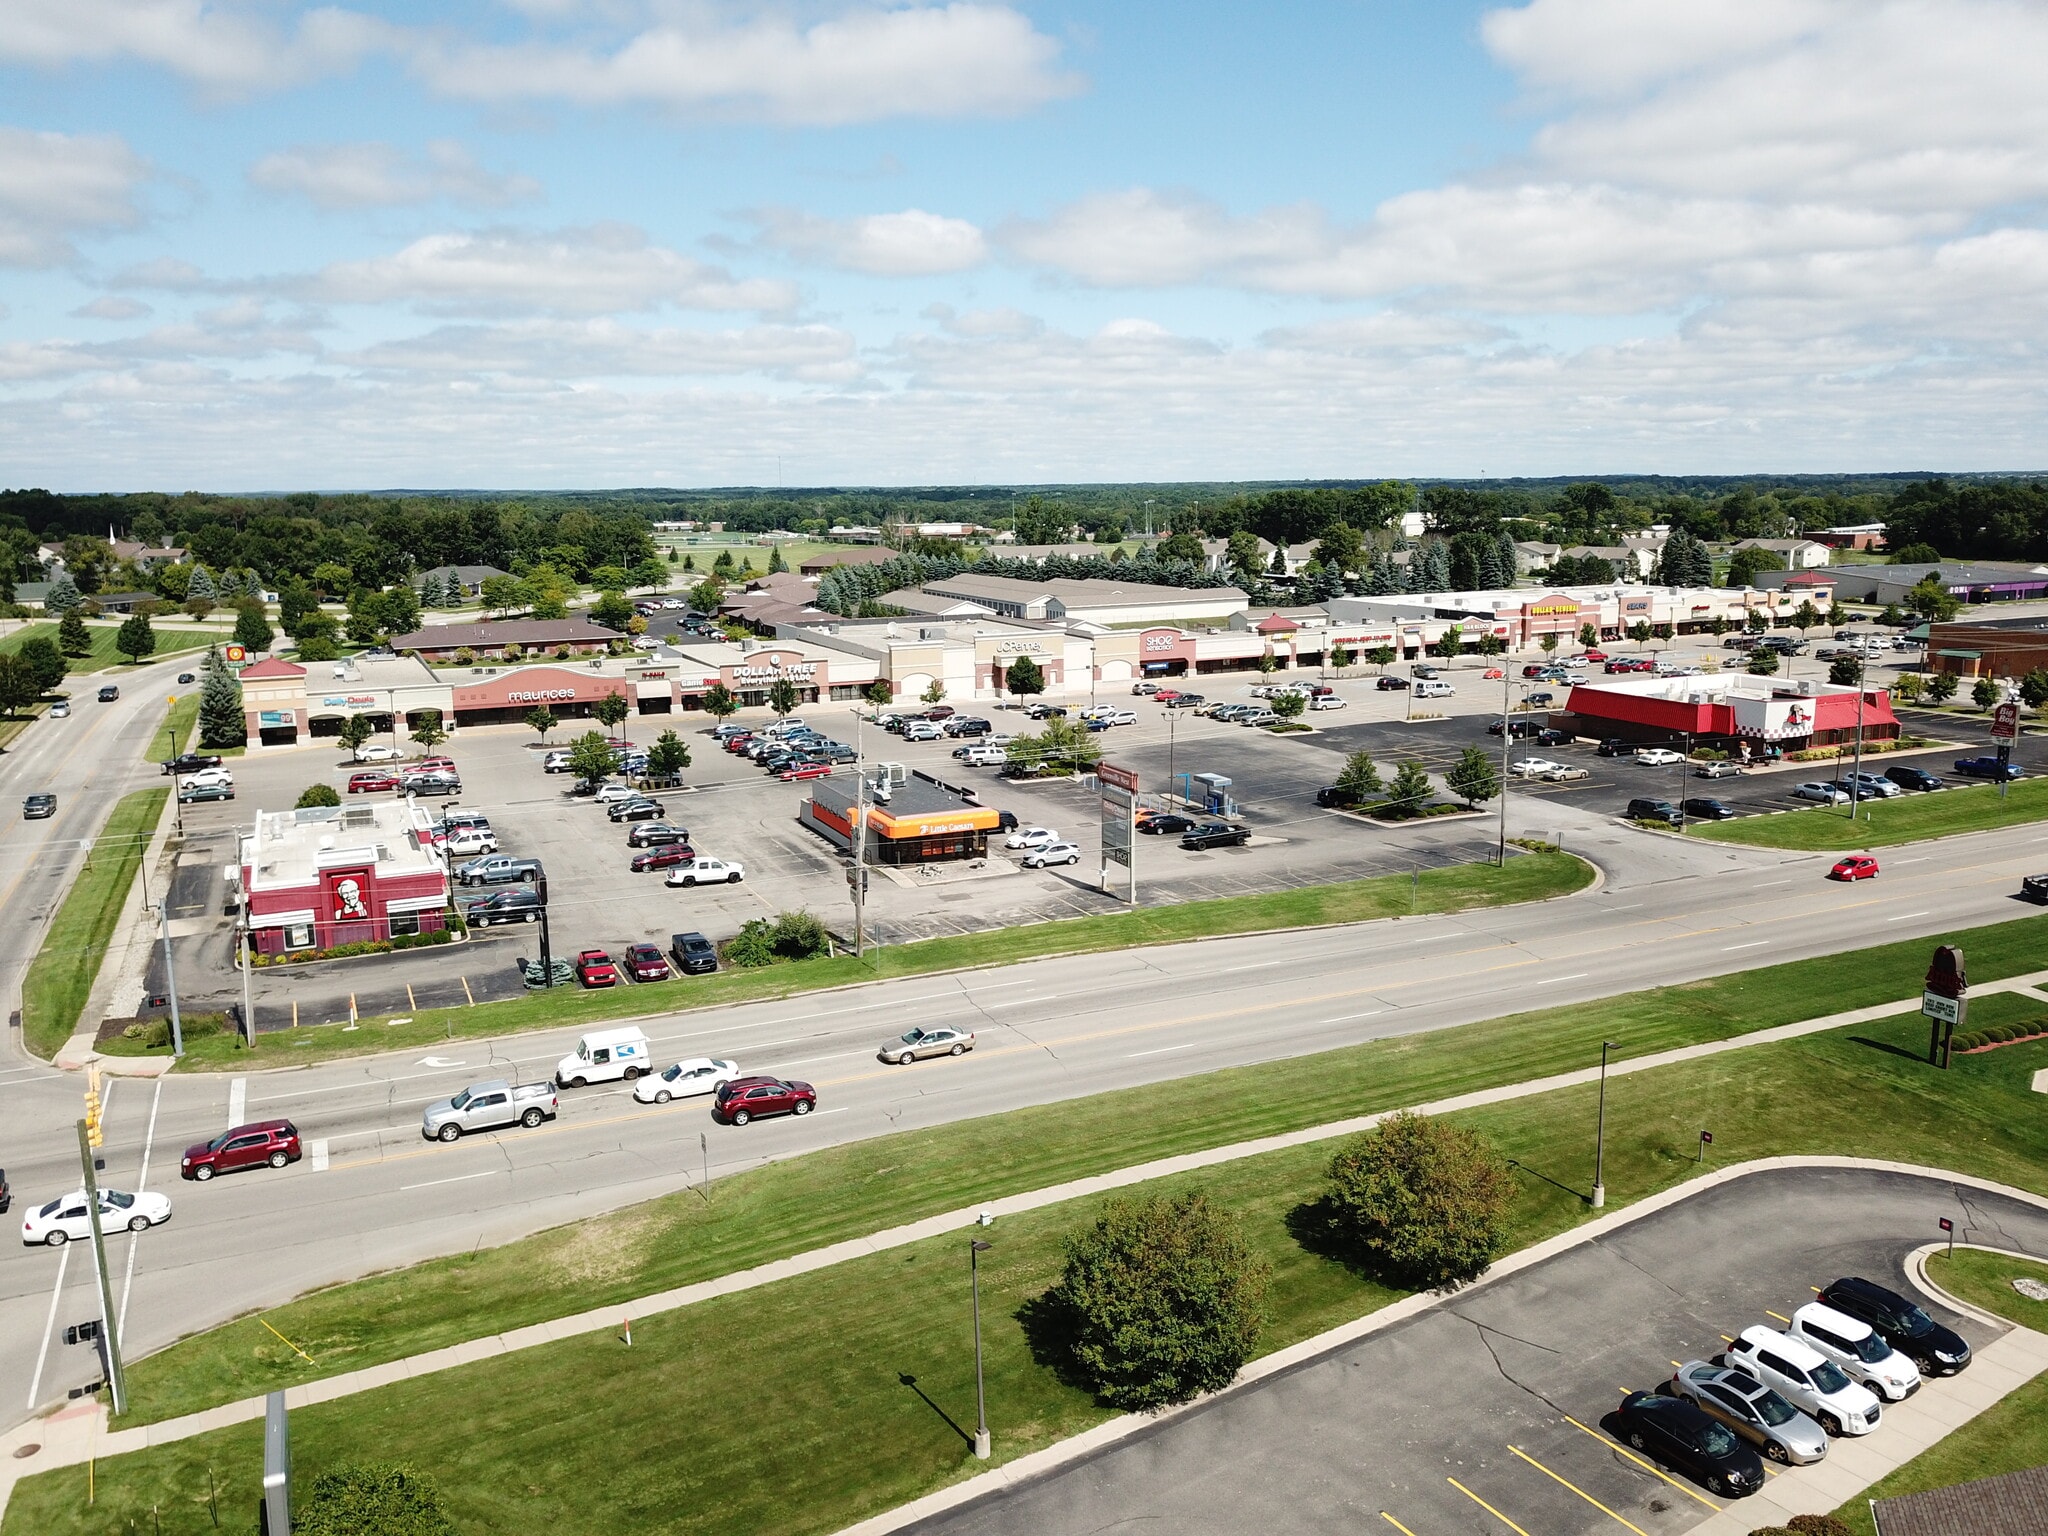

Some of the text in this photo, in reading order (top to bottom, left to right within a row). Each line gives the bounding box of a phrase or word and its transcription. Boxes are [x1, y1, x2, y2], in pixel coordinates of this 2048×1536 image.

[1949, 586, 1968, 594] BOWL
[1555, 605, 1579, 613] GENERAL
[997, 640, 1042, 653] JCPenney
[733, 663, 818, 677] DOLLAR TREE
[508, 688, 576, 701] maurices
[1999, 707, 2014, 718] Big
[1998, 715, 2015, 726] Boy
[930, 823, 975, 833] Little Caesars
